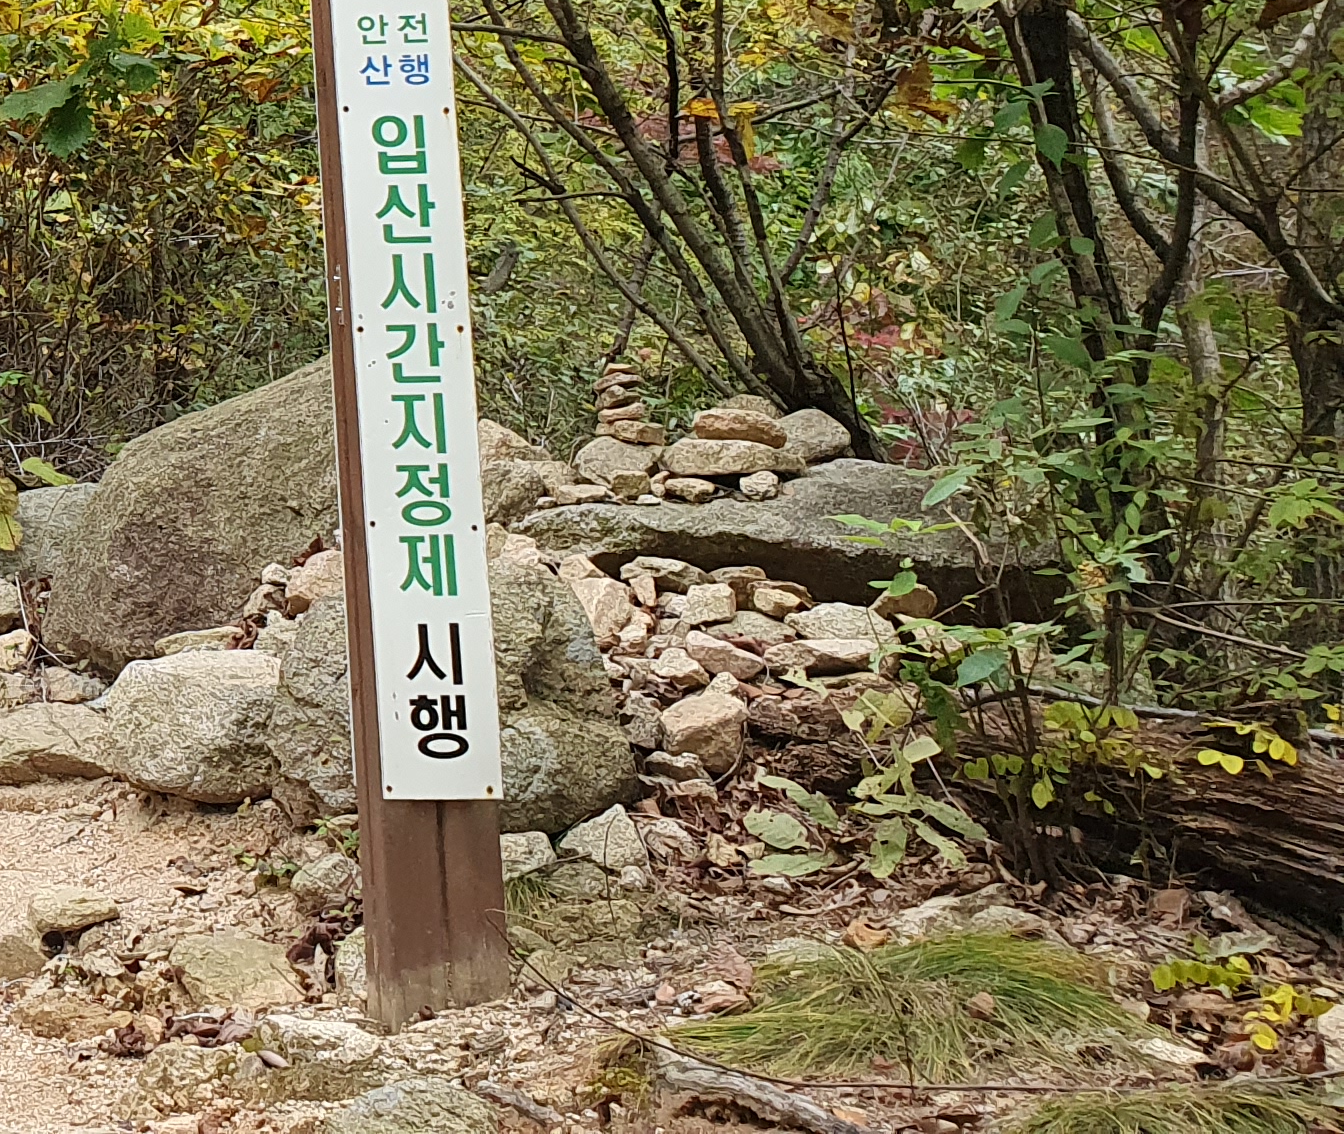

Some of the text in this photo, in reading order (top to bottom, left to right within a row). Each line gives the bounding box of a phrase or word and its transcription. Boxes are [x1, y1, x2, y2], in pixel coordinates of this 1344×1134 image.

[357, 13, 429, 46] 안전
[358, 52, 431, 87] 산행
[371, 114, 470, 760] 입산시간지정제 시행
